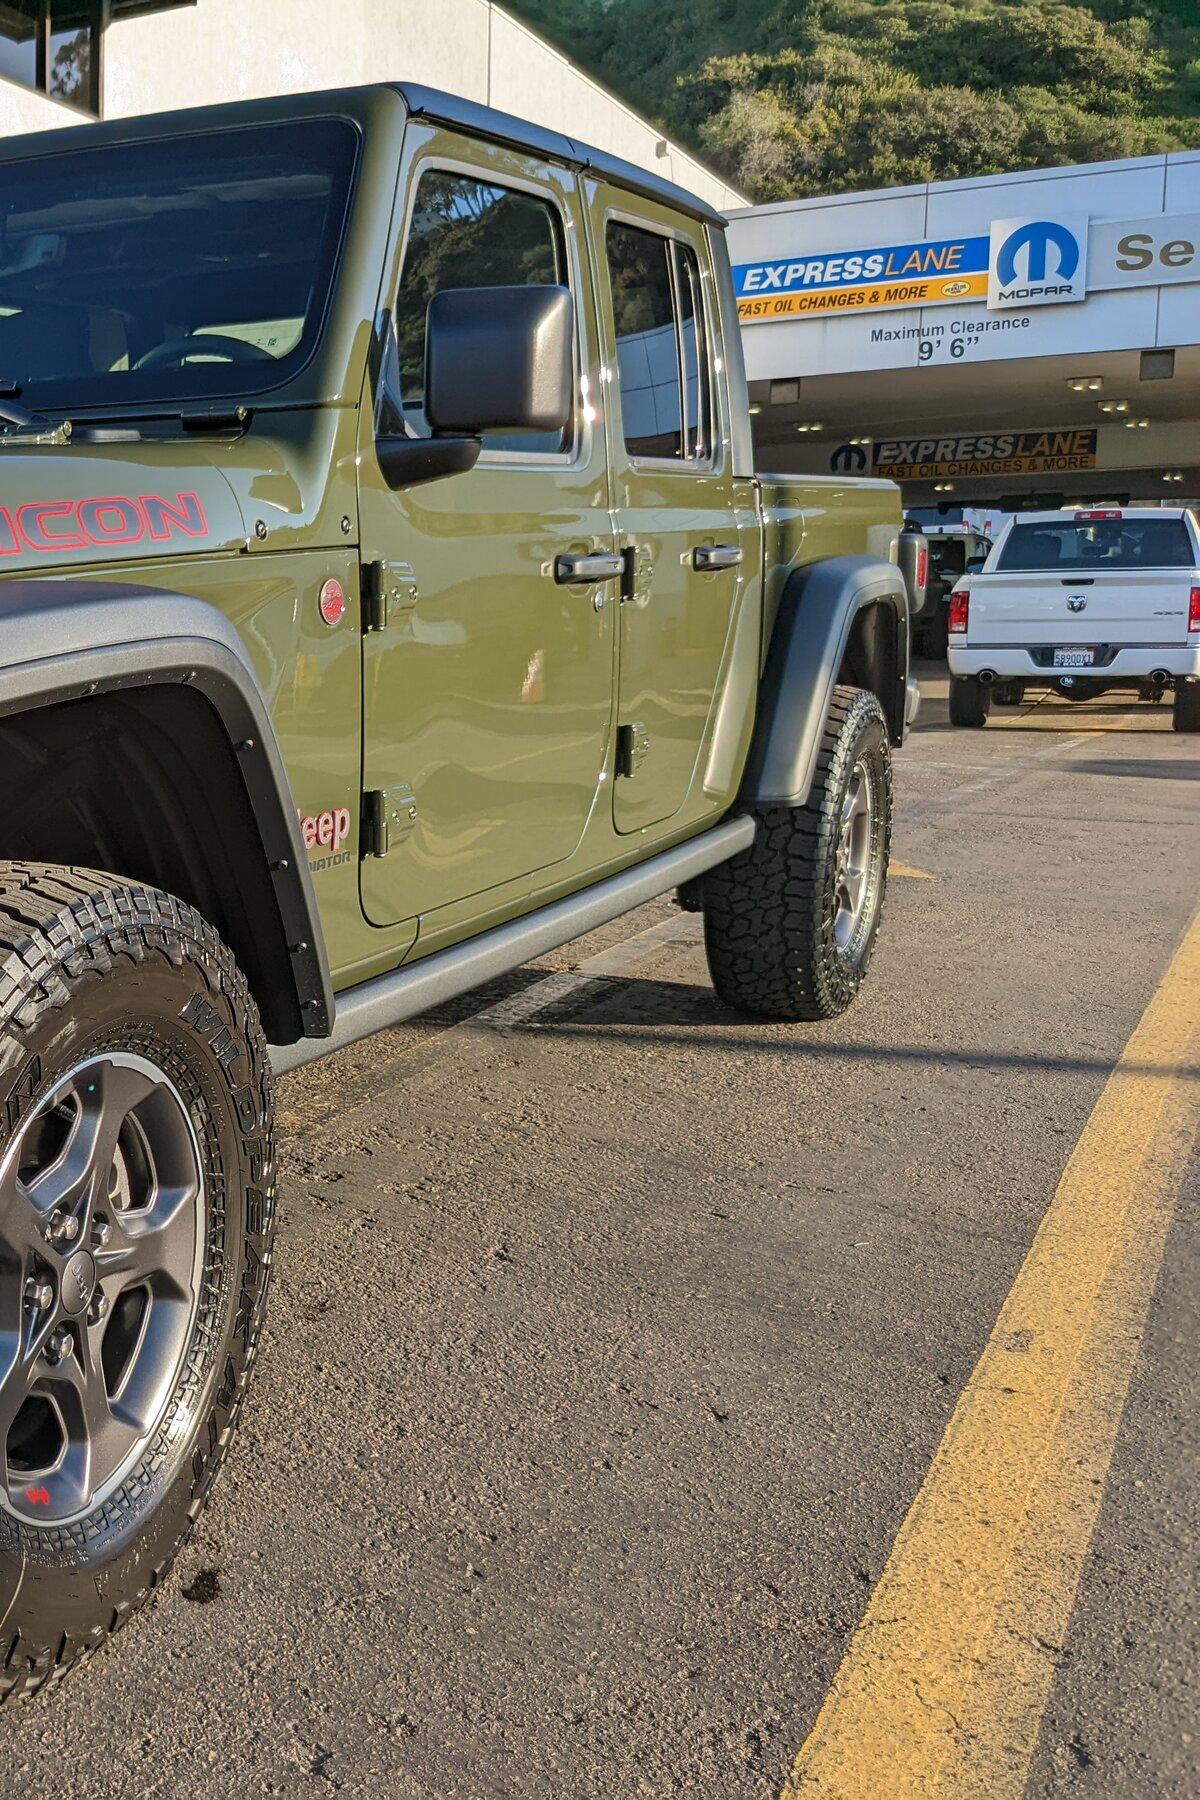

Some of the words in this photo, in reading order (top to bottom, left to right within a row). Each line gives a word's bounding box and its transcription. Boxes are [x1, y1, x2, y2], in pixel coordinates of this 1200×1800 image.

[738, 301, 772, 317] FAST
[774, 299, 795, 313] OIL
[800, 291, 865, 310] CHANGES
[868, 291, 880, 304] &
[883, 285, 928, 301] MORE
[998, 285, 1073, 300] MOPAR
[871, 325, 945, 342] Maximum
[950, 317, 1030, 334] Clearance
[878, 464, 914, 478] FAST
[919, 464, 943, 477] OIL
[947, 459, 1022, 475] CHANGES
[1028, 459, 1038, 471] &
[1043, 456, 1089, 470] MORE
[297, 807, 351, 851] eep
